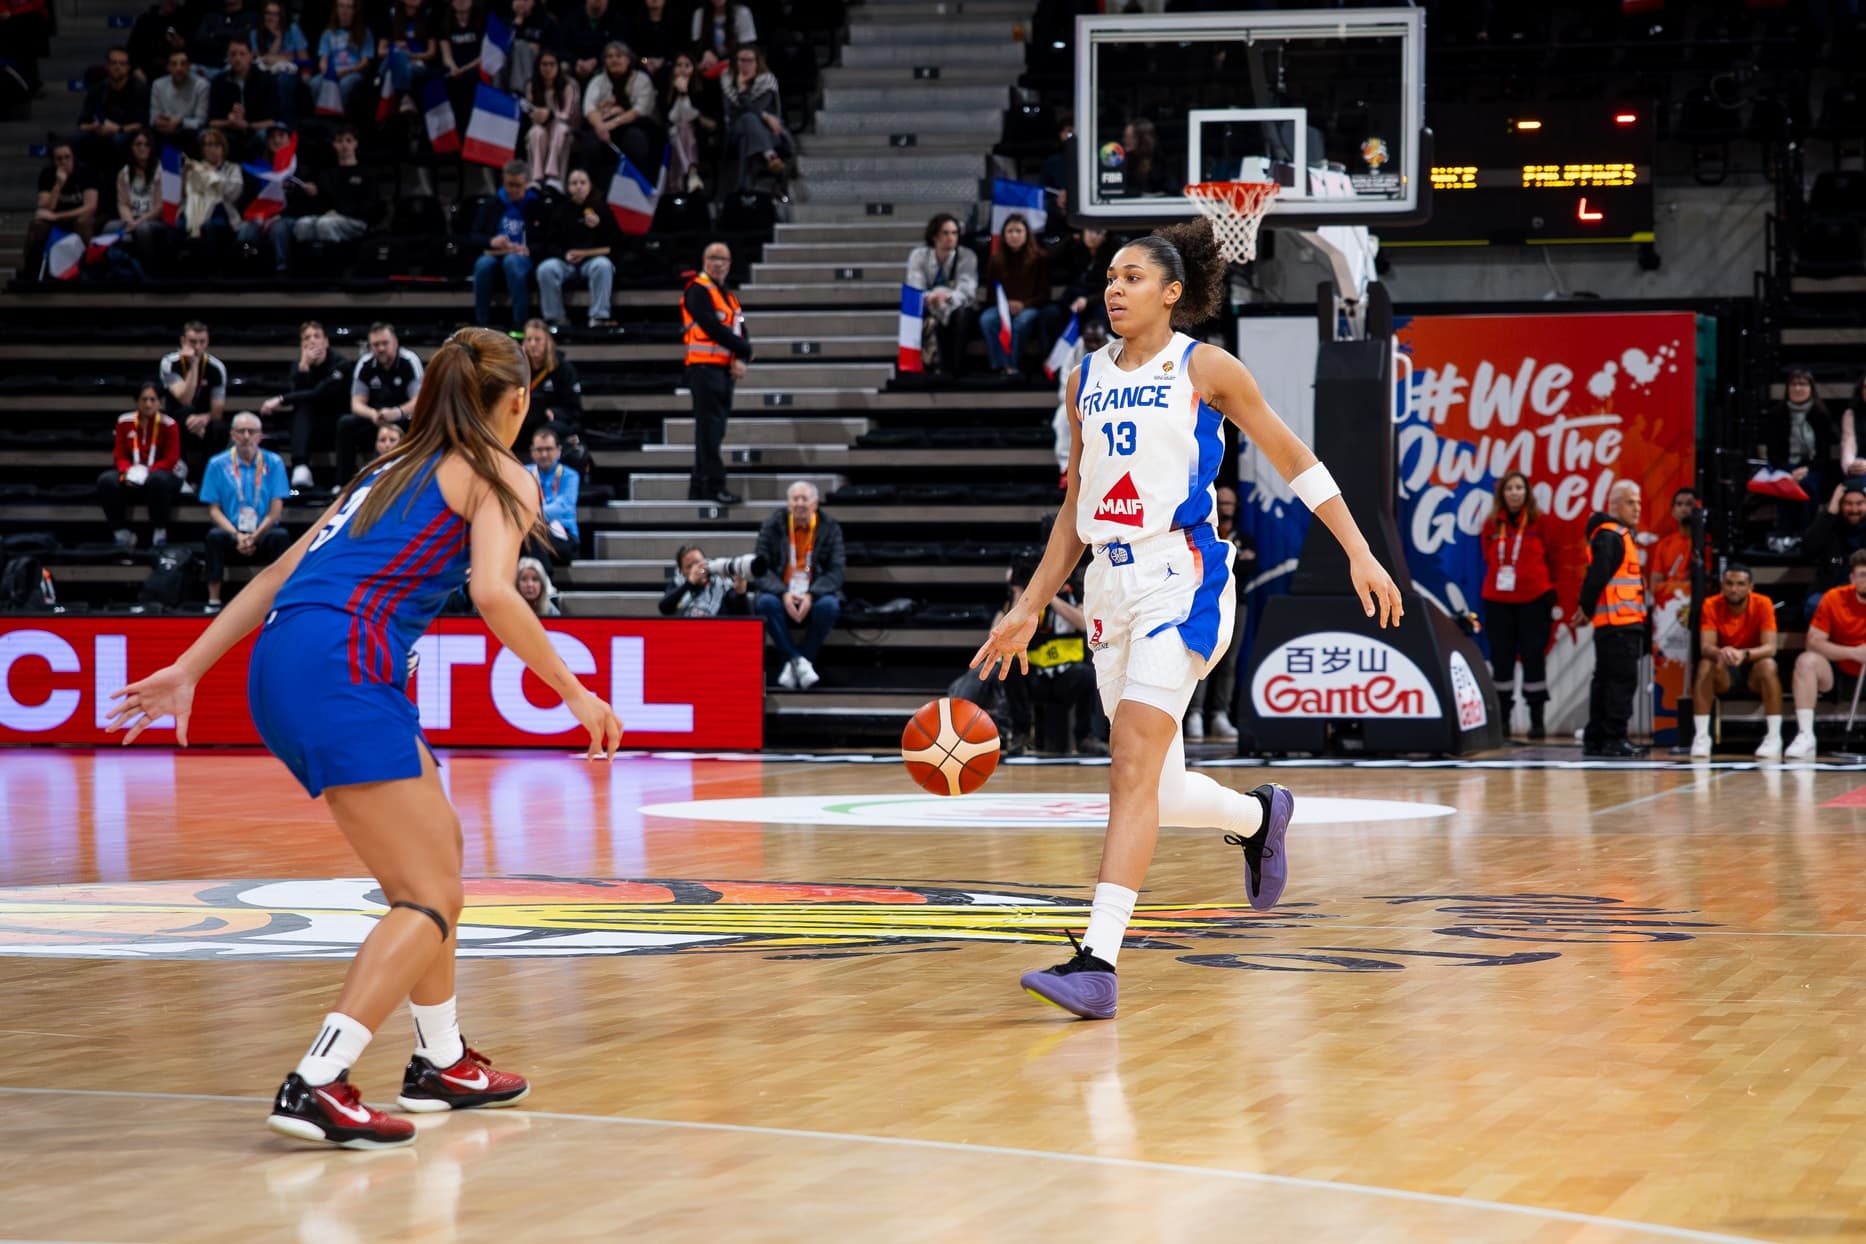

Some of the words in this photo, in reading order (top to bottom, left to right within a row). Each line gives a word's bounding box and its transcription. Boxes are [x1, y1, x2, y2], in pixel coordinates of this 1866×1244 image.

[1083, 385, 1171, 420] FRANCE
[1411, 357, 1573, 430] #We
[1101, 421, 1137, 457] 13
[1098, 498, 1144, 516] MAIF
[1286, 647, 1387, 673] 百岁山
[410, 630, 694, 735] TCL
